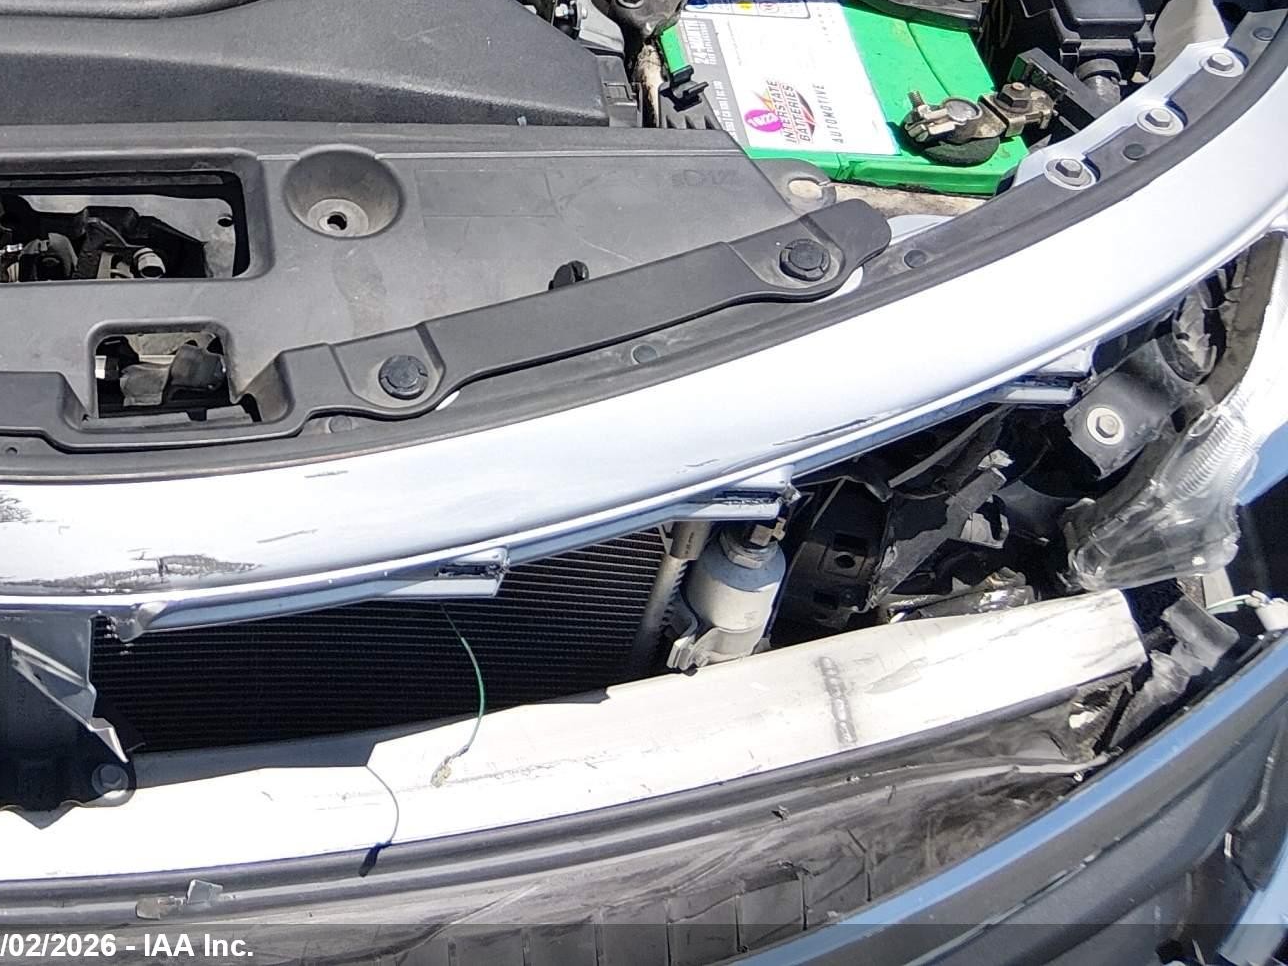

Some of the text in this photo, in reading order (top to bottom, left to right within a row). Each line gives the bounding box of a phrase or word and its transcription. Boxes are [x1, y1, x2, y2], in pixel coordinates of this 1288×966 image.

[766, 79, 798, 144] INTERSTATE
[782, 84, 811, 143] BATTERIES
[812, 83, 844, 144] AUTOMOTIVE
